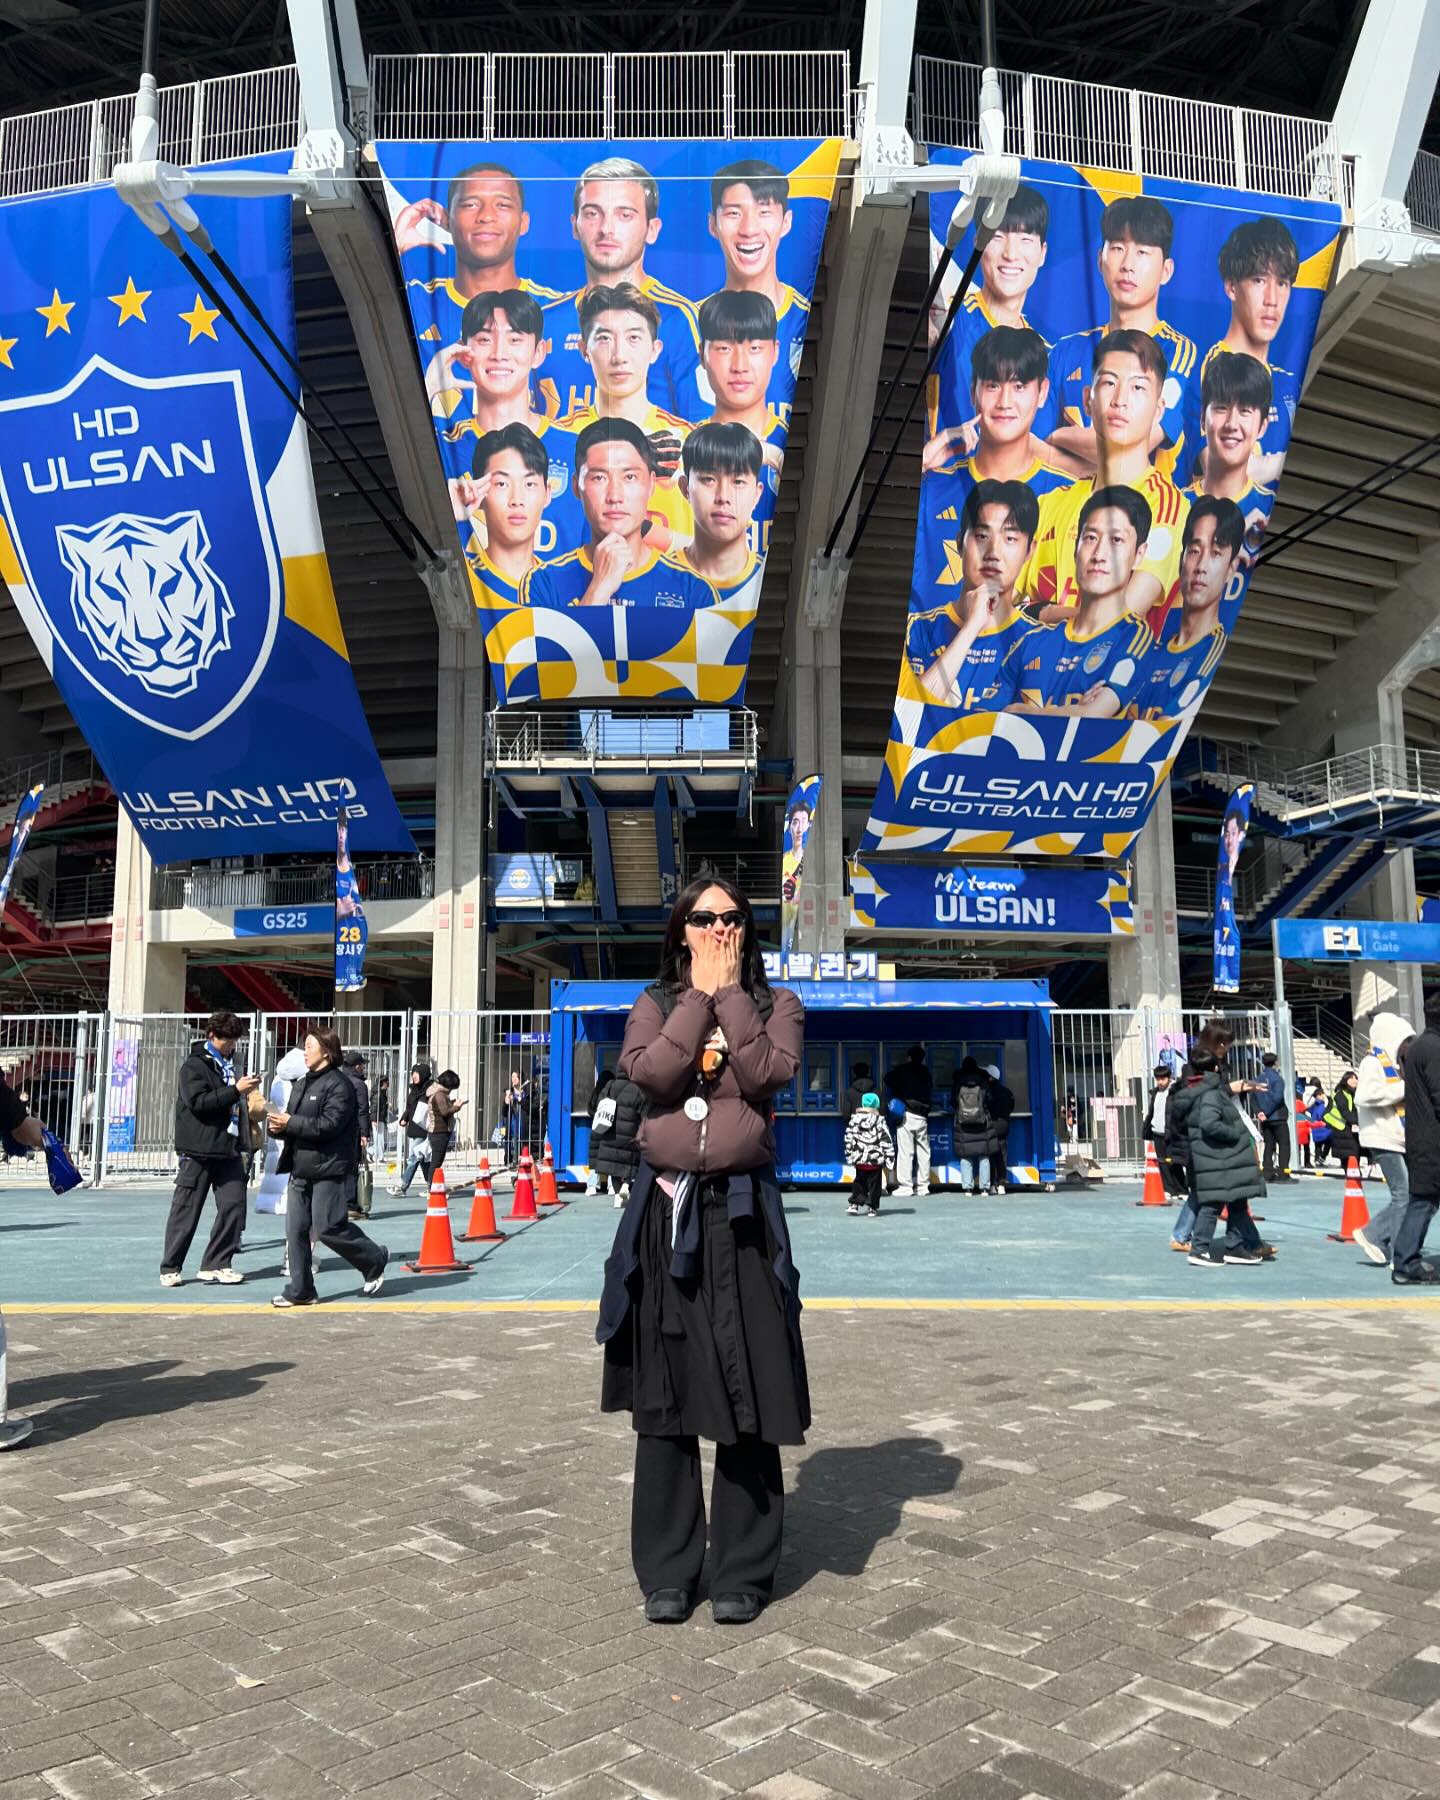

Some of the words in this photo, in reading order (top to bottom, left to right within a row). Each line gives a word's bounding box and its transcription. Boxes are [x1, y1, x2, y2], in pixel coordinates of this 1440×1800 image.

[72, 405, 140, 441] HD
[22, 439, 216, 495] ULSAN
[122, 786, 274, 813] ULSAN
[276, 776, 357, 806] HD
[918, 771, 1089, 802] ULSAN
[1092, 781, 1148, 803] HD
[138, 813, 277, 831] FOOTBALL
[279, 803, 368, 824] CLUB
[910, 797, 1067, 819] FOOTBALL
[1073, 806, 1138, 819] CLUB
[934, 872, 963, 894] My
[967, 874, 1017, 893] team
[262, 912, 307, 929] GS25
[935, 895, 1056, 927] ULSAN!
[339, 926, 361, 942] 28
[1323, 925, 1362, 951] E1
[1372, 940, 1400, 953] Gate
[761, 952, 877, 979] 인발권기
